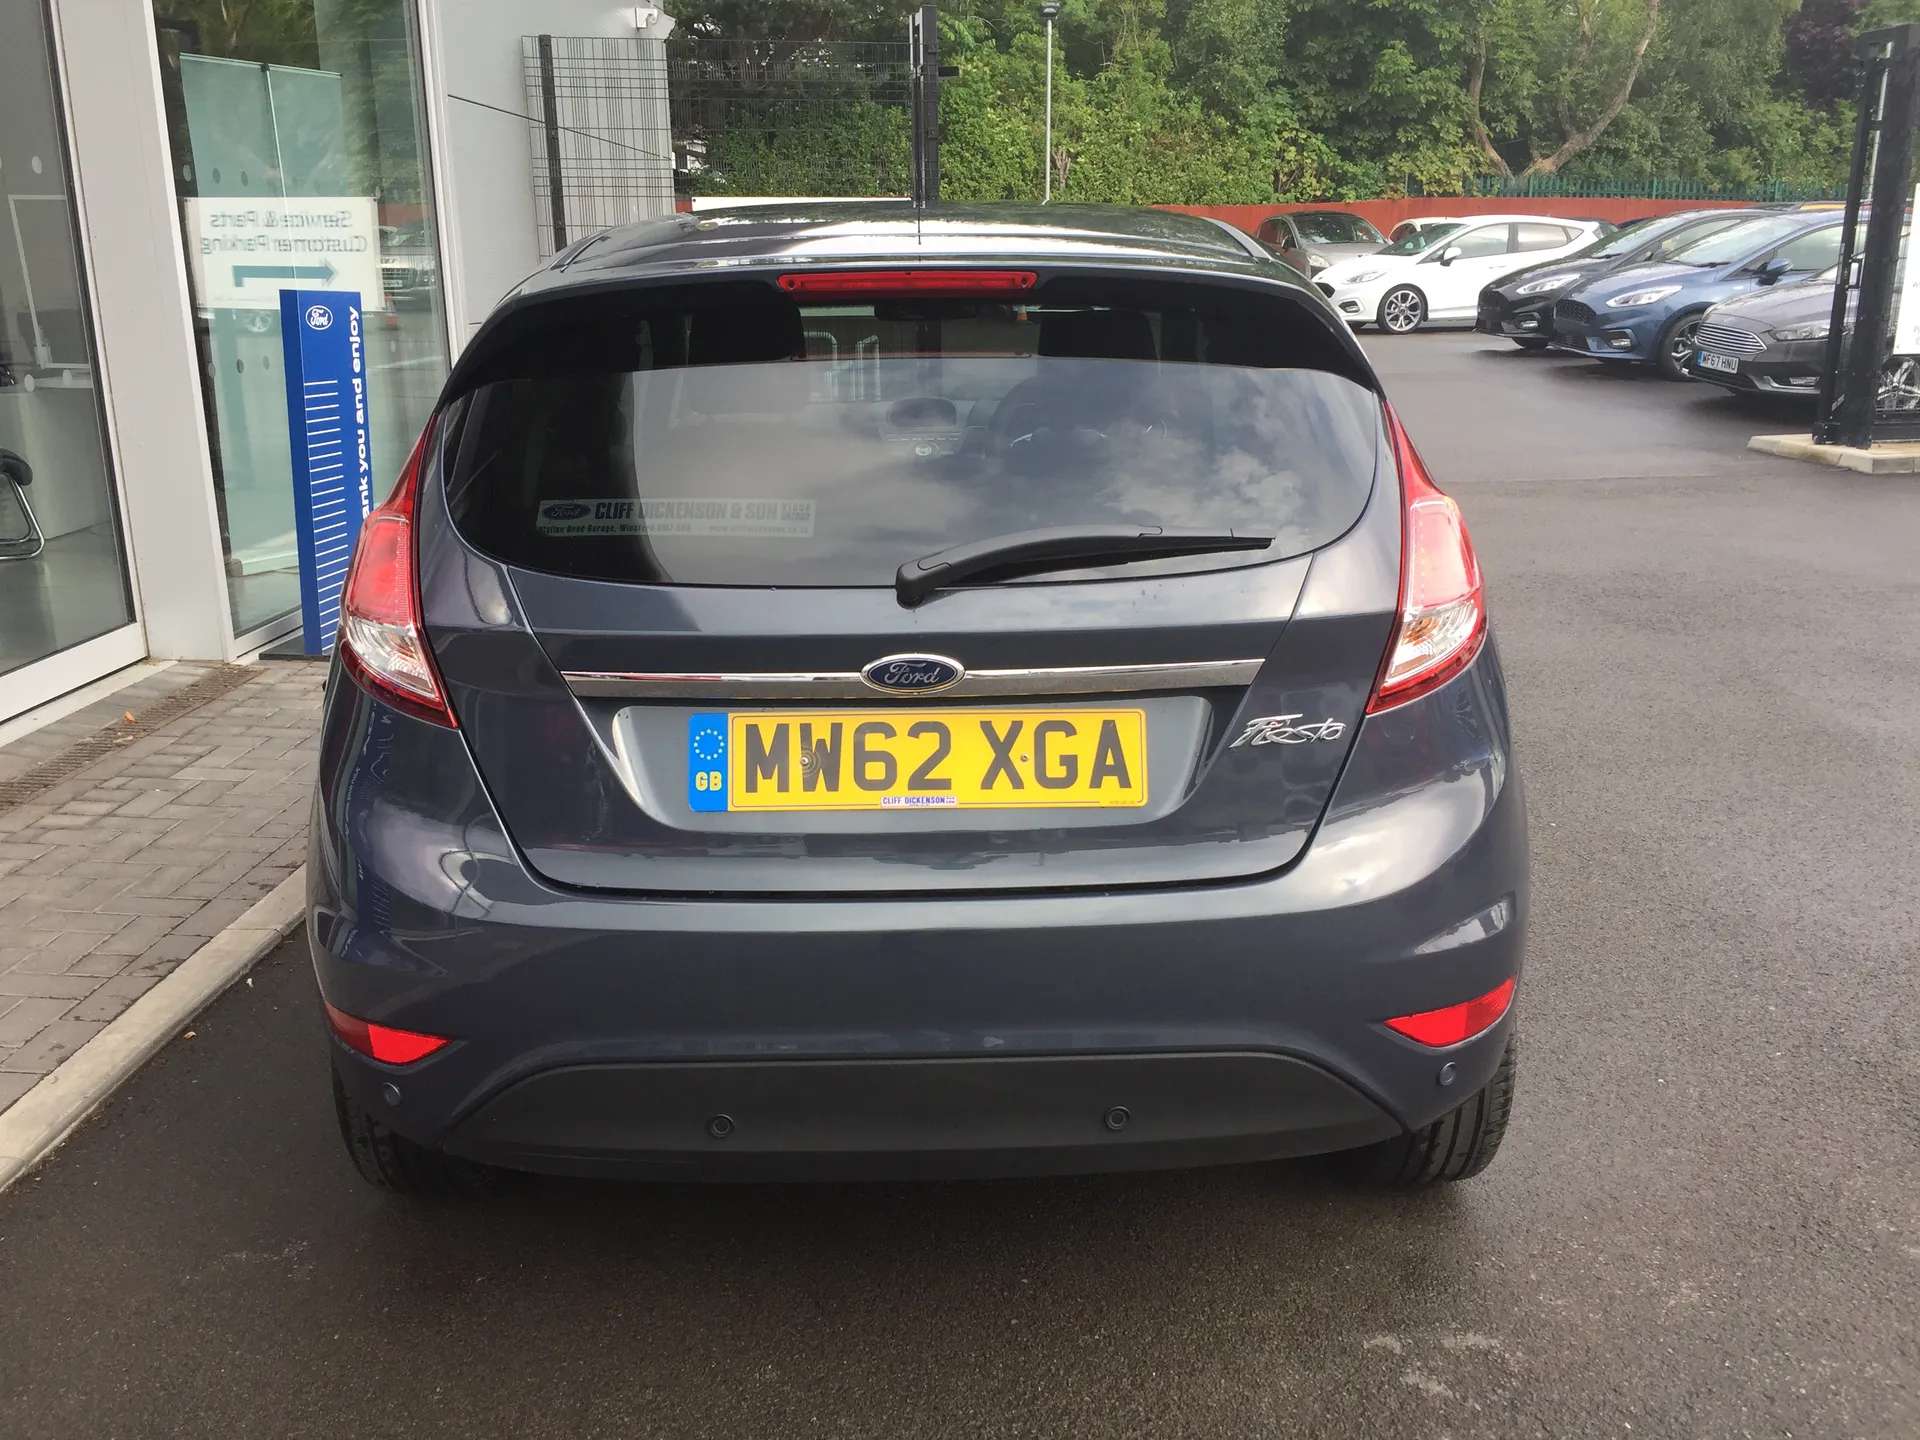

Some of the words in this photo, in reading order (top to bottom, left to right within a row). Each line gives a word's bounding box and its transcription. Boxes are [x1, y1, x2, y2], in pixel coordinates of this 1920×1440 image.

[309, 308, 329, 327] Ford
[349, 306, 361, 373] enjoy
[353, 378, 364, 424] and
[359, 430, 369, 473] you
[360, 475, 370, 519] ank
[594, 502, 635, 520] CLIFF
[638, 502, 728, 520] DICKENSON
[745, 502, 779, 521] SON
[884, 662, 941, 684] Ford
[1228, 713, 1346, 748] Fiesta
[745, 721, 952, 793] MW62
[979, 719, 1132, 790] XGA
[695, 771, 722, 792] GB
[882, 796, 902, 805] CLIFF
[904, 796, 945, 805] DICKENSON
